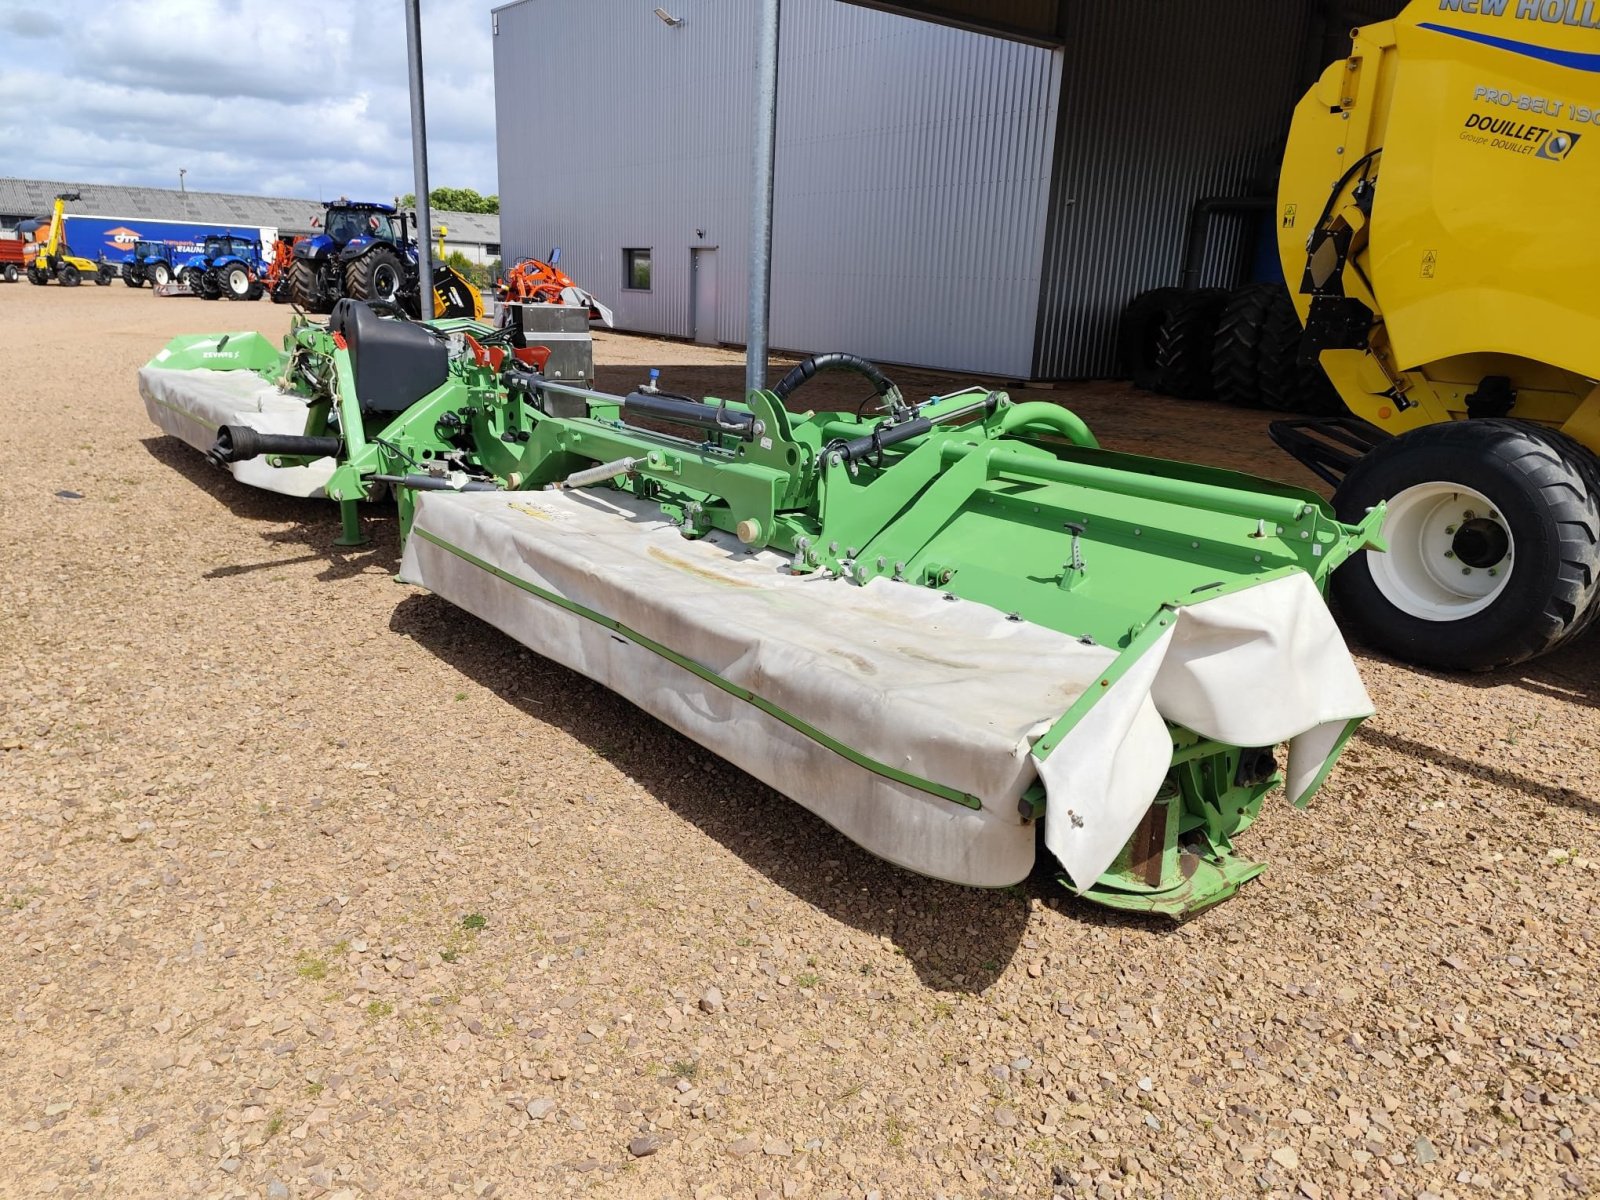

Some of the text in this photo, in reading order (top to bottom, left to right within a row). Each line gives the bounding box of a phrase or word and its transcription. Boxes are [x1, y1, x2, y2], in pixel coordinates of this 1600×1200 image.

[1515, 0, 1600, 29] HOLL
[1473, 84, 1565, 118] PRO-BELT
[1464, 113, 1549, 143] DOUILLET
[1459, 131, 1535, 155] Groupe DOUILLET
